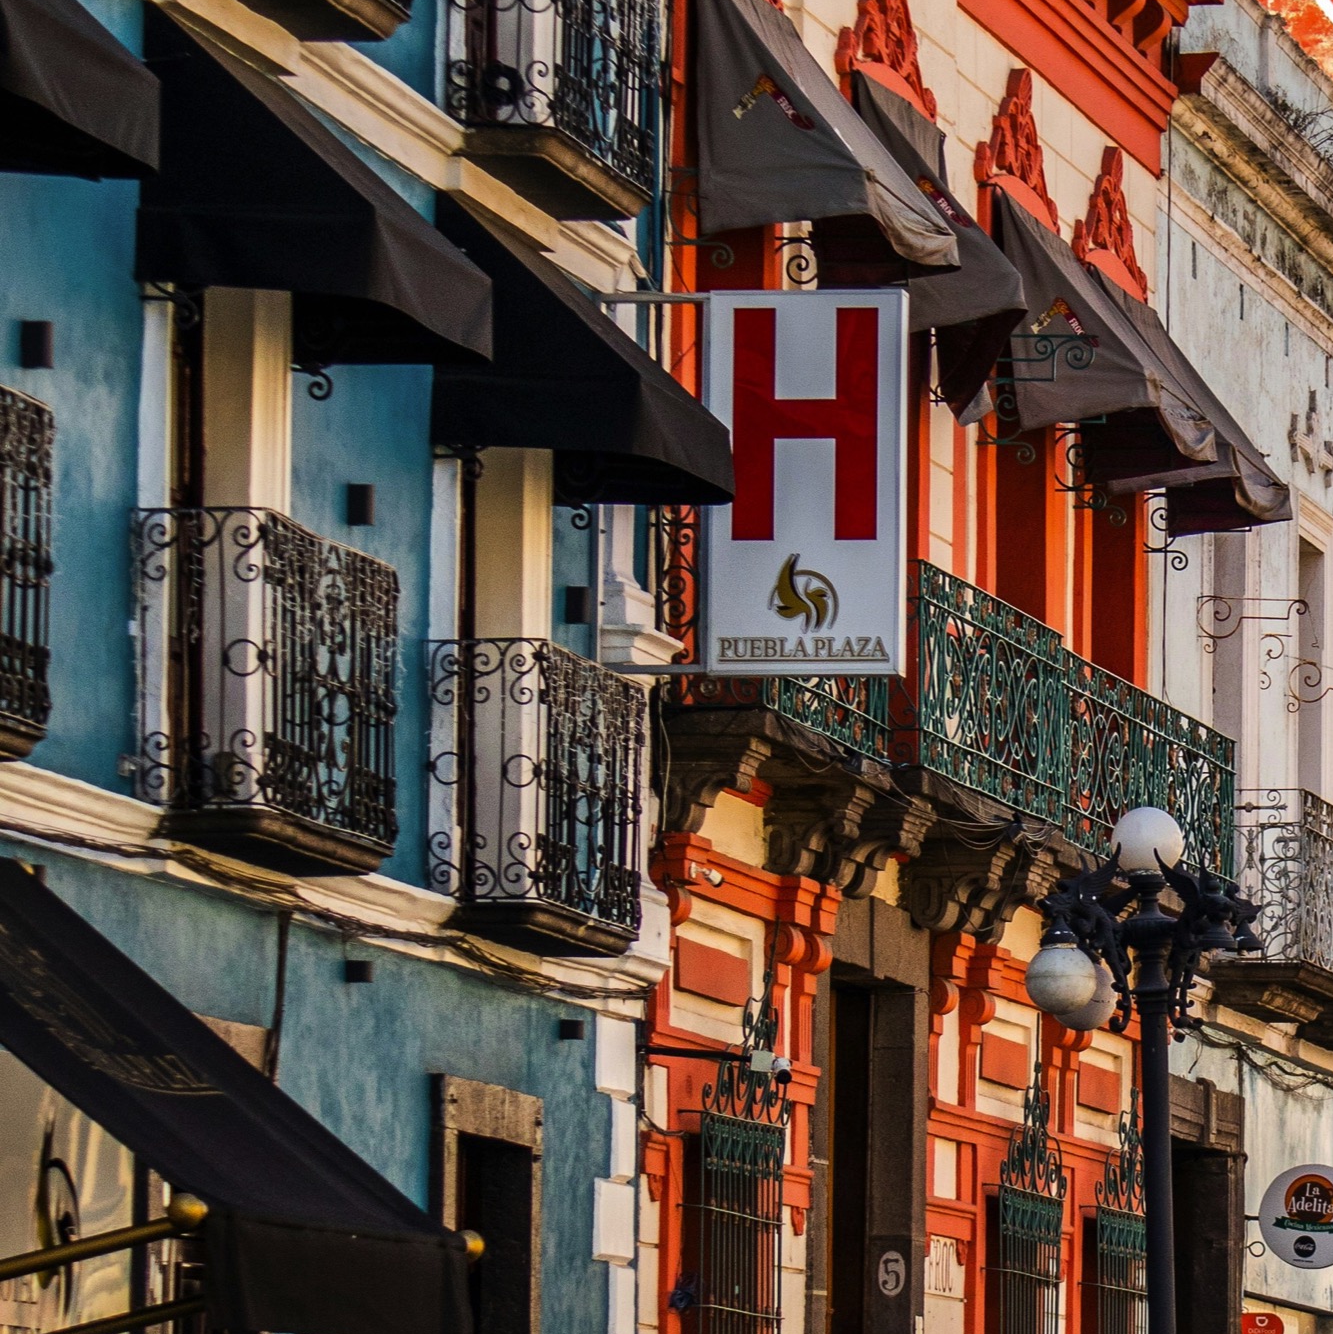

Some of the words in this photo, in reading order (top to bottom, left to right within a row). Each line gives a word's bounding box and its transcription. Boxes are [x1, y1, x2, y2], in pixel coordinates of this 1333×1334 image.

[731, 307, 879, 541] H
[718, 637, 808, 658] PUEBLA
[814, 637, 888, 658] PLAZA
[1306, 1183, 1320, 1197] La
[881, 1257, 901, 1291] 5
